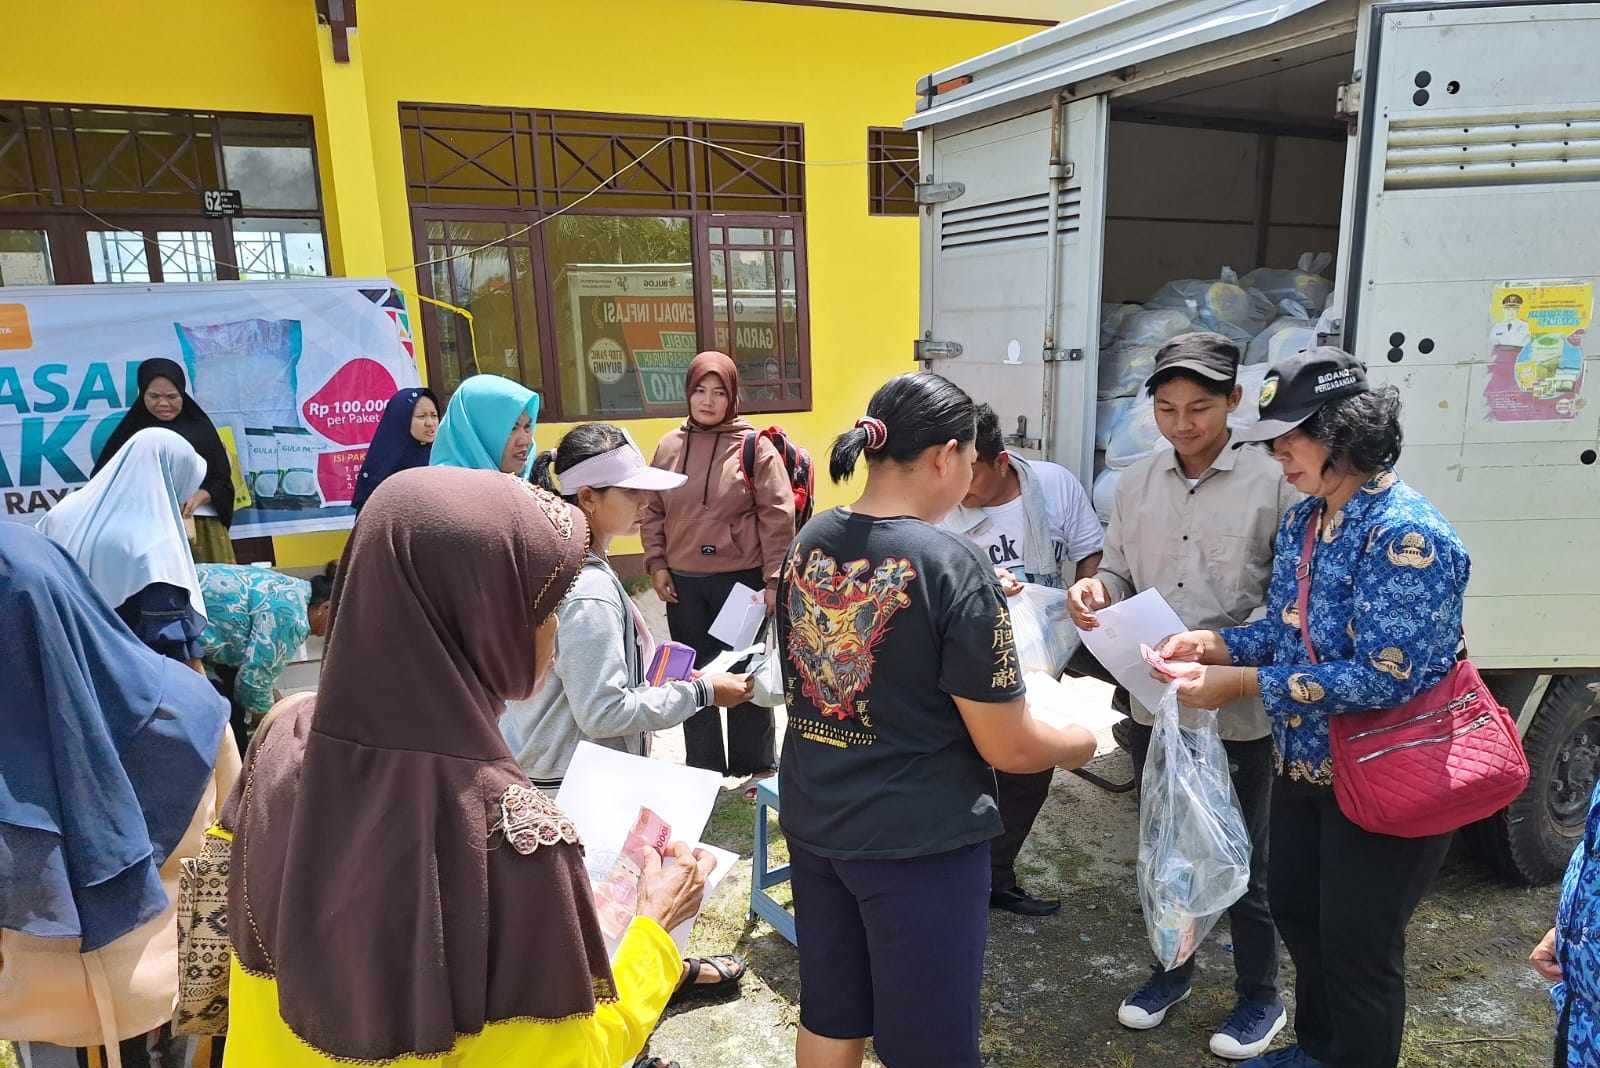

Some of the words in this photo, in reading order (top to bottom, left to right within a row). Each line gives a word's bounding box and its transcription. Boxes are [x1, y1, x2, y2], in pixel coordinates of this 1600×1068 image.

[204, 191, 222, 211] 62
[309, 403, 329, 418] Rp
[327, 416, 346, 428] per
[349, 413, 381, 424] Paket
[347, 453, 367, 462] PAK
[5, 487, 84, 515] RAY
[991, 607, 1018, 690] 大胆不敵
